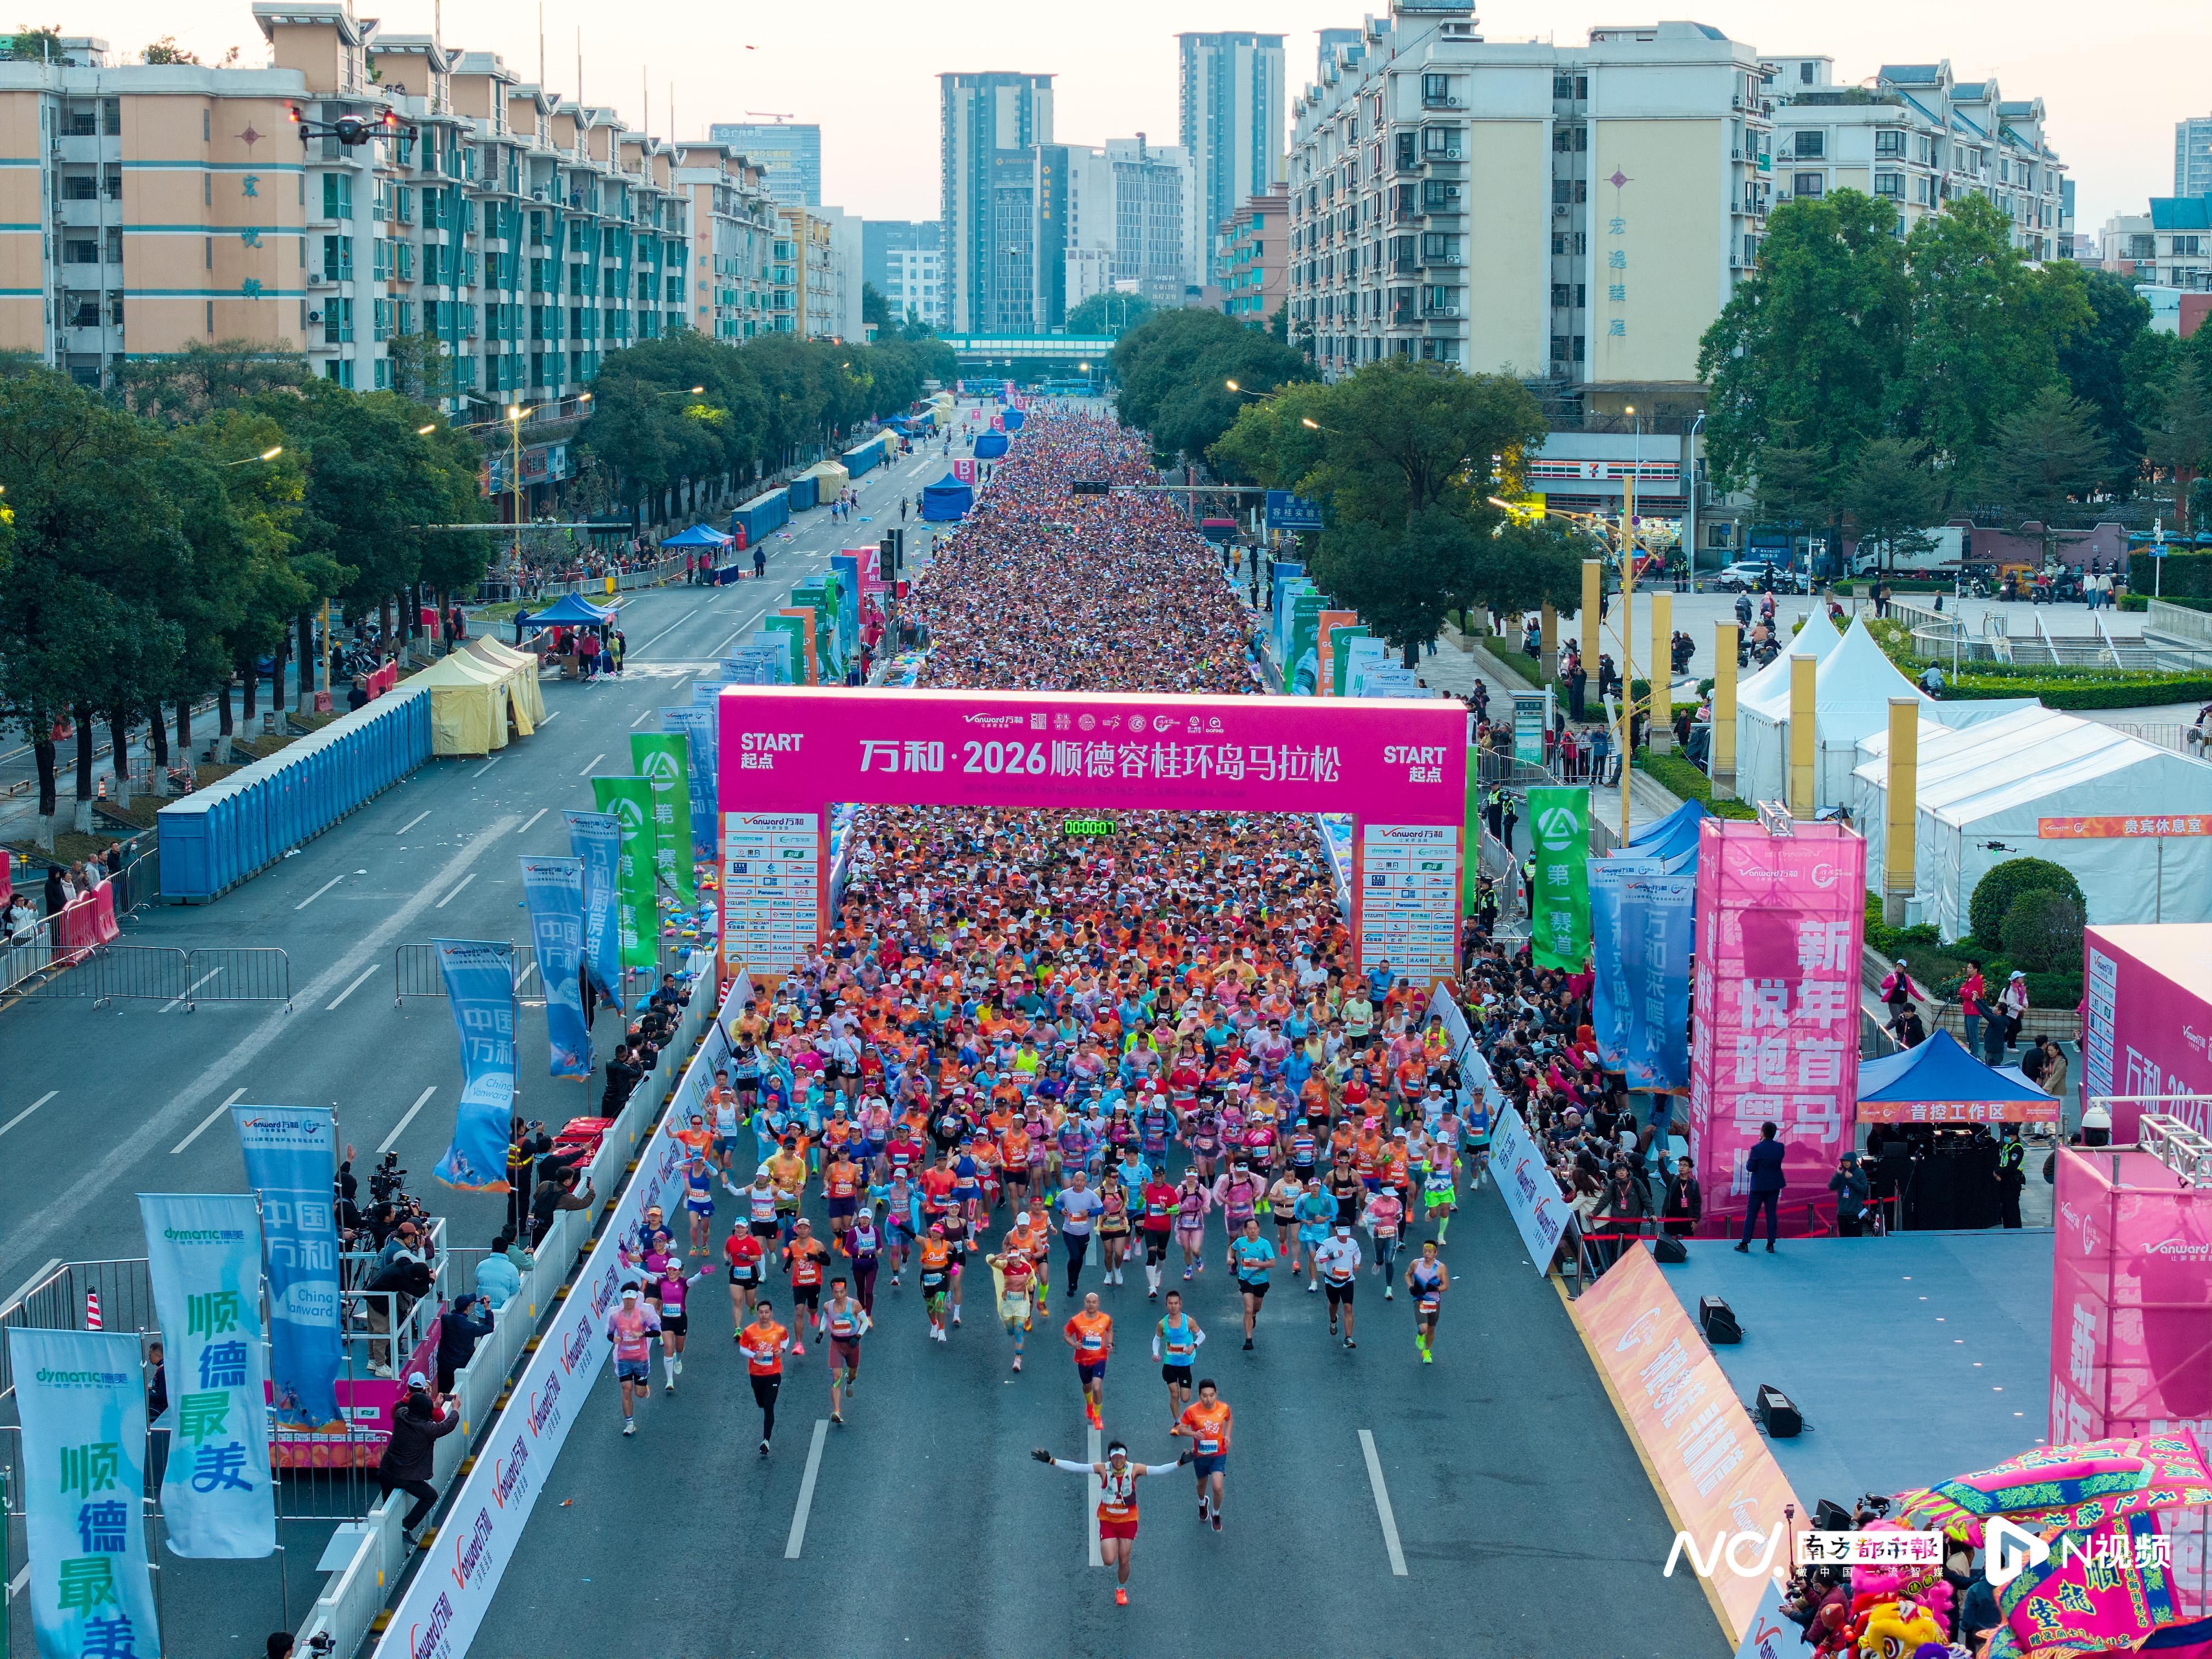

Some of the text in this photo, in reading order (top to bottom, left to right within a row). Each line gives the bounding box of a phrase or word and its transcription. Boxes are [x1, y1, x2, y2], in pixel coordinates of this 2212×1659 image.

[993, 417, 1000, 426] C
[960, 461, 970, 475] B
[866, 550, 881, 573] A
[962, 713, 1004, 723] Vanward
[741, 733, 804, 751] START
[741, 753, 774, 770] 起点
[1384, 746, 1447, 764] START
[1409, 766, 1442, 783] 起点
[740, 815, 784, 825] Vanward
[1065, 821, 1114, 834] 00:00:07
[2124, 819, 2201, 833] 贵宾休息室
[1379, 827, 1423, 837] Vanward
[1738, 867, 1779, 877] Vanward
[1626, 882, 1655, 890] Vanward
[1547, 864, 1573, 955] 第一赛道
[540, 919, 580, 945] 中国
[543, 947, 577, 972] 万和
[463, 1008, 513, 1035] 中国
[1792, 921, 1850, 1144] 新年首马
[469, 1037, 513, 1064] 万和
[486, 1078, 512, 1091] China
[2125, 1044, 2212, 1141] 万和·2026
[473, 1087, 509, 1101] Vanward
[1911, 1104, 2004, 1120] 音控工作区
[242, 1118, 281, 1128] Vanward
[262, 1199, 330, 1232] 中国
[163, 1227, 220, 1240] dymatic
[267, 1237, 333, 1271] 万和
[2141, 1238, 2209, 1254] Vanward
[298, 1289, 333, 1303] China
[36, 1367, 100, 1383] dymatic
[179, 1290, 253, 1493] 顺德最美
[57, 1442, 136, 1659] 顺德最美
